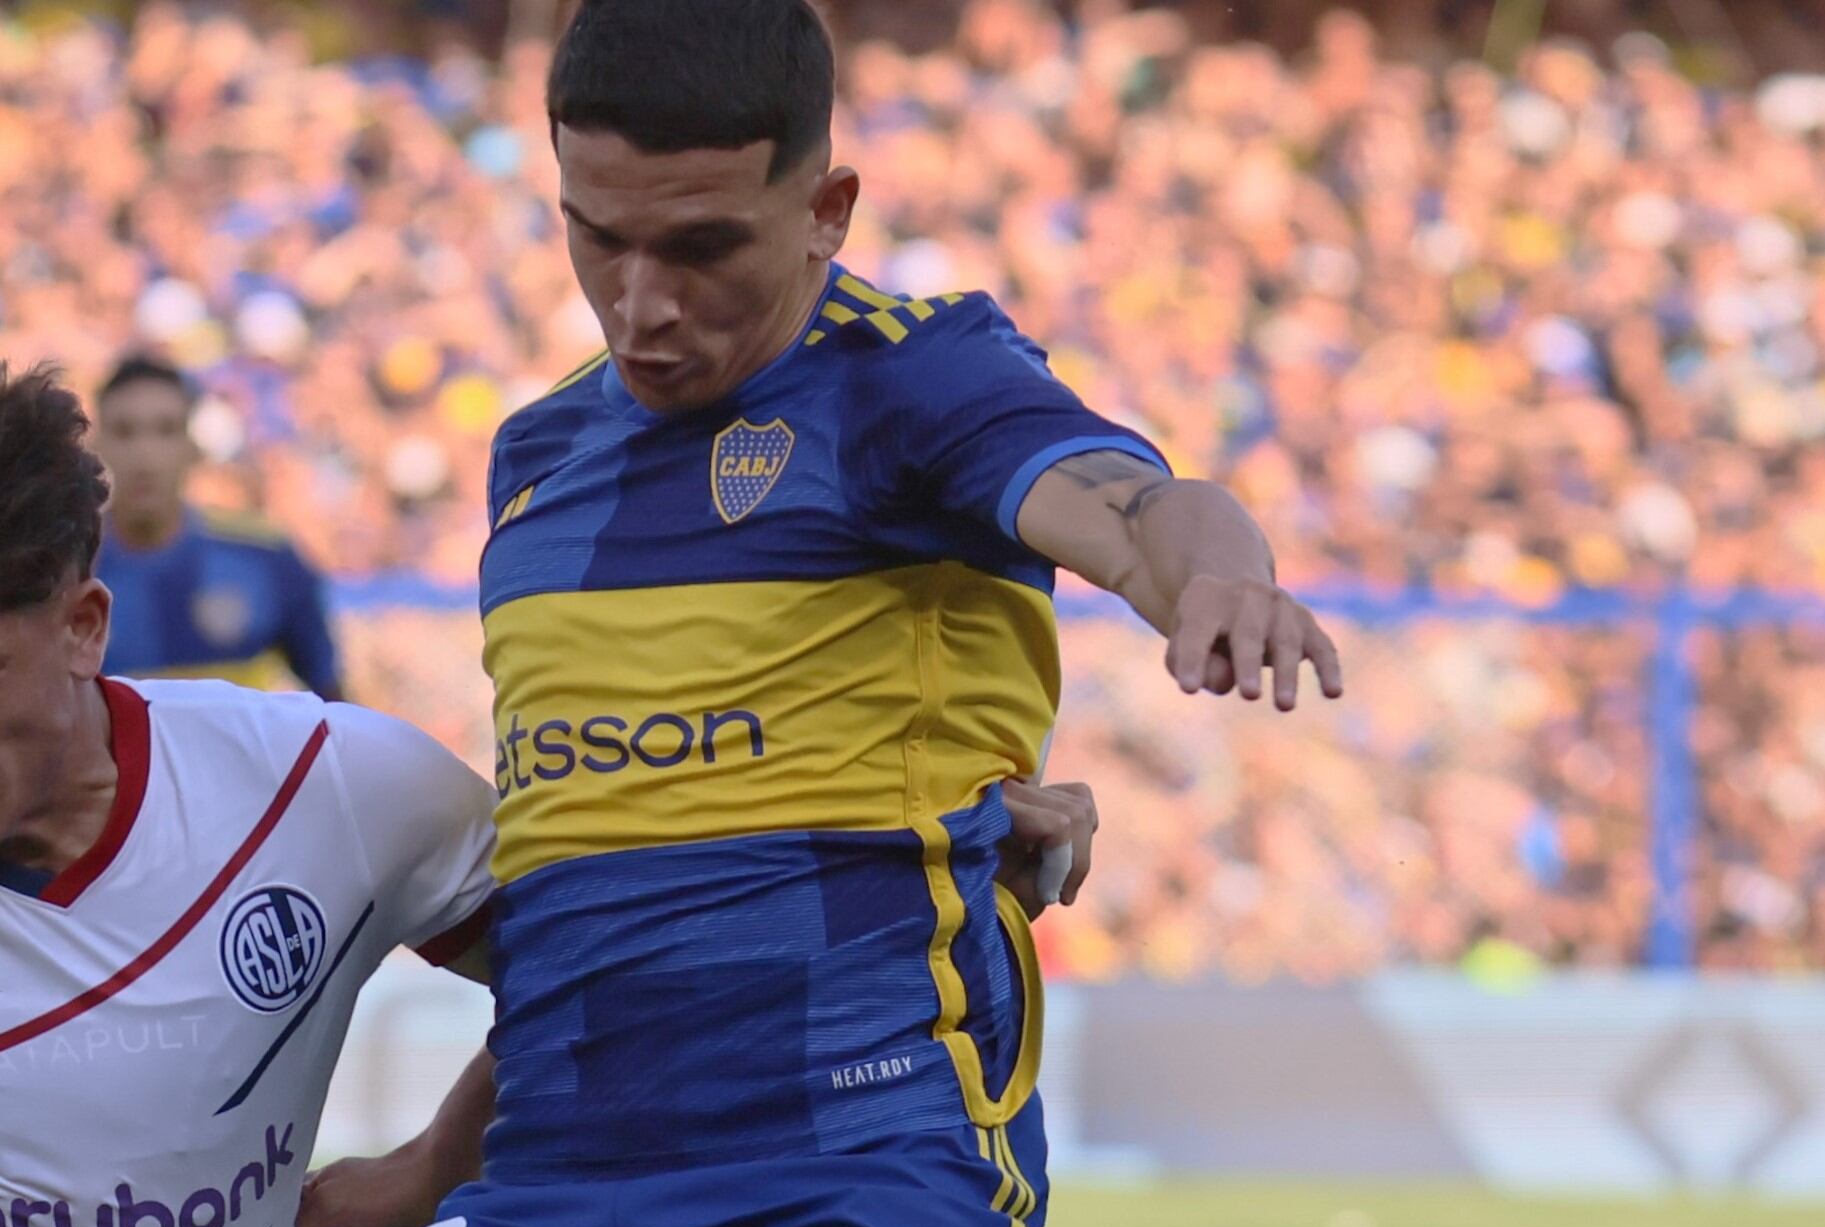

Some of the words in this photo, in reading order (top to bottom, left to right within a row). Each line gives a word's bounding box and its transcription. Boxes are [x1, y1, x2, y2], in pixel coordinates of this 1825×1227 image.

[719, 456, 780, 477] CABJ
[495, 709, 764, 800] etsson
[831, 1056, 912, 1089] HEAT.RDY
